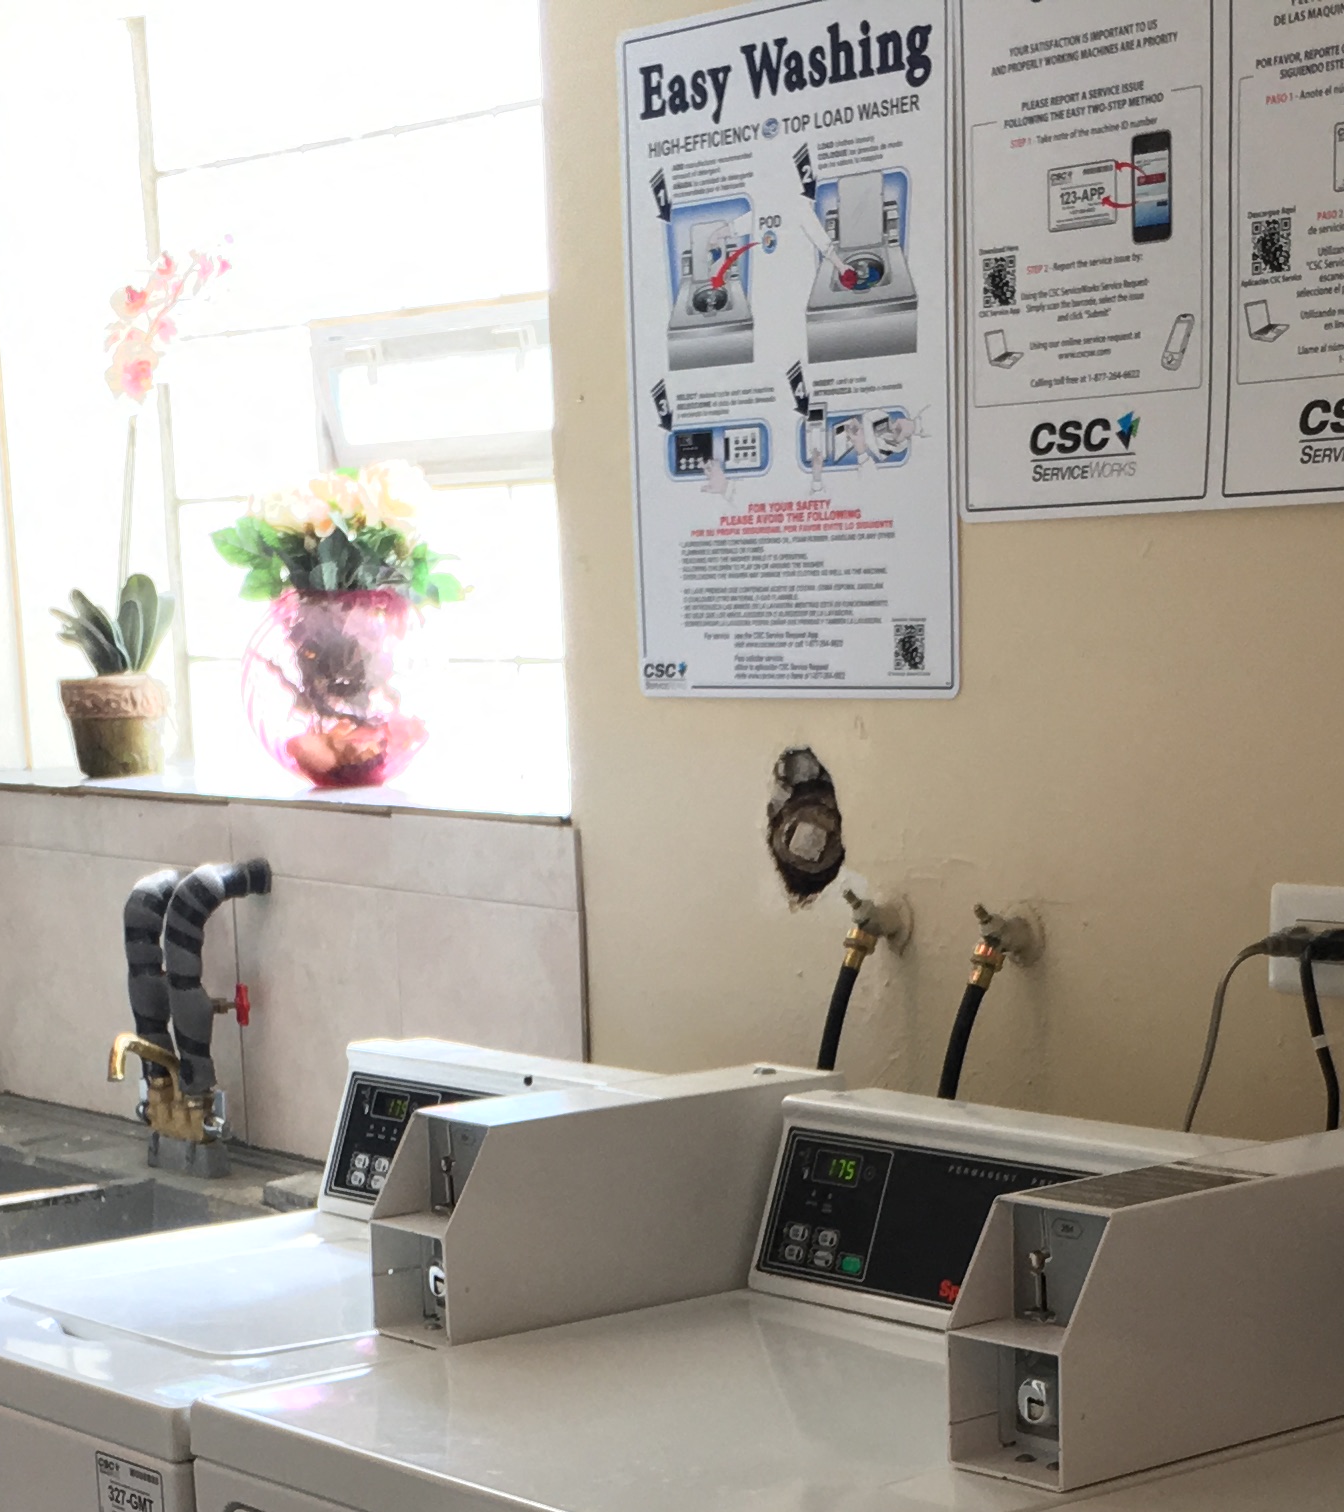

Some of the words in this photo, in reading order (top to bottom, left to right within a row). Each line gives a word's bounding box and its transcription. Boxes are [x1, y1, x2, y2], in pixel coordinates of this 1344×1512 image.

[1274, 14, 1287, 26] DE
[1288, 10, 1306, 23] LAS
[1136, 22, 1146, 32] TO
[1120, 39, 1134, 49] ARE
[1143, 32, 1178, 46] PRIORITY
[1256, 57, 1272, 68] POR
[1304, 46, 1339, 61] REPORTE
[640, 64, 732, 124] Easy
[741, 20, 932, 99] Washing
[1280, 63, 1324, 80] SIGUIENDO
[1326, 58, 1344, 71] ESTE
[1022, 98, 1048, 111] PLEASE
[1089, 85, 1120, 99] SERVICE
[1122, 80, 1144, 93] ISSUE
[1051, 110, 1065, 120] THE
[1066, 107, 1086, 118] EASY
[649, 123, 760, 157] HIGH-EFFICIENCY
[782, 114, 810, 134] TOP
[814, 106, 853, 129] LOAD
[858, 94, 920, 121] WASHER
[656, 192, 667, 205] 1
[1060, 187, 1105, 205] 123-APP
[759, 215, 781, 230] POD
[1030, 418, 1111, 455] CSC
[769, 501, 794, 512] YOUR
[797, 499, 831, 511] SAFETY
[720, 515, 753, 526] PLEASE
[756, 514, 783, 524] AVOID
[787, 512, 804, 522] THE
[644, 663, 676, 678] CSC
[827, 1157, 856, 1180] 175
